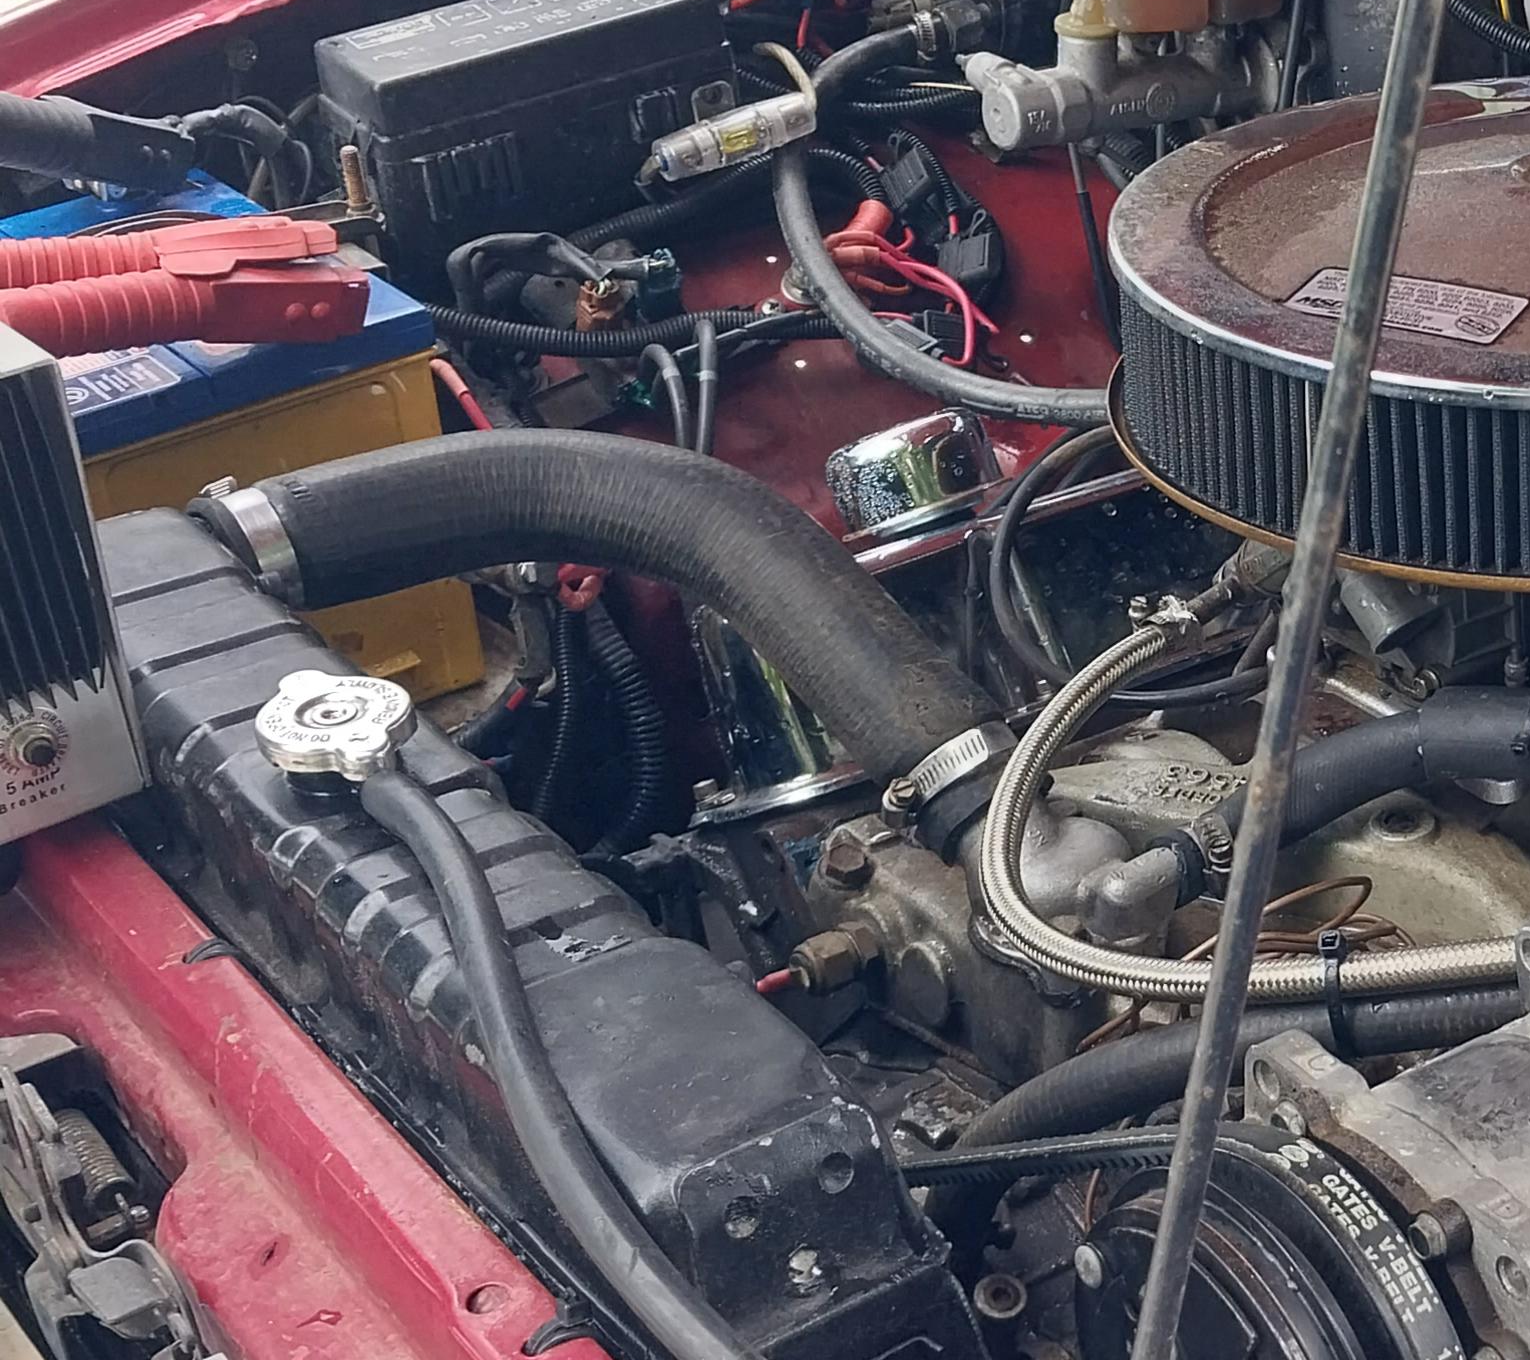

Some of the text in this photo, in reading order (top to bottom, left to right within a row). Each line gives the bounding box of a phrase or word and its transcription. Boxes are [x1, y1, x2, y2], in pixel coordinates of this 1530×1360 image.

[0, 783, 66, 815] Breaker
[1322, 1174, 1378, 1230] GATES
[1379, 1235, 1432, 1313] V-BELT
